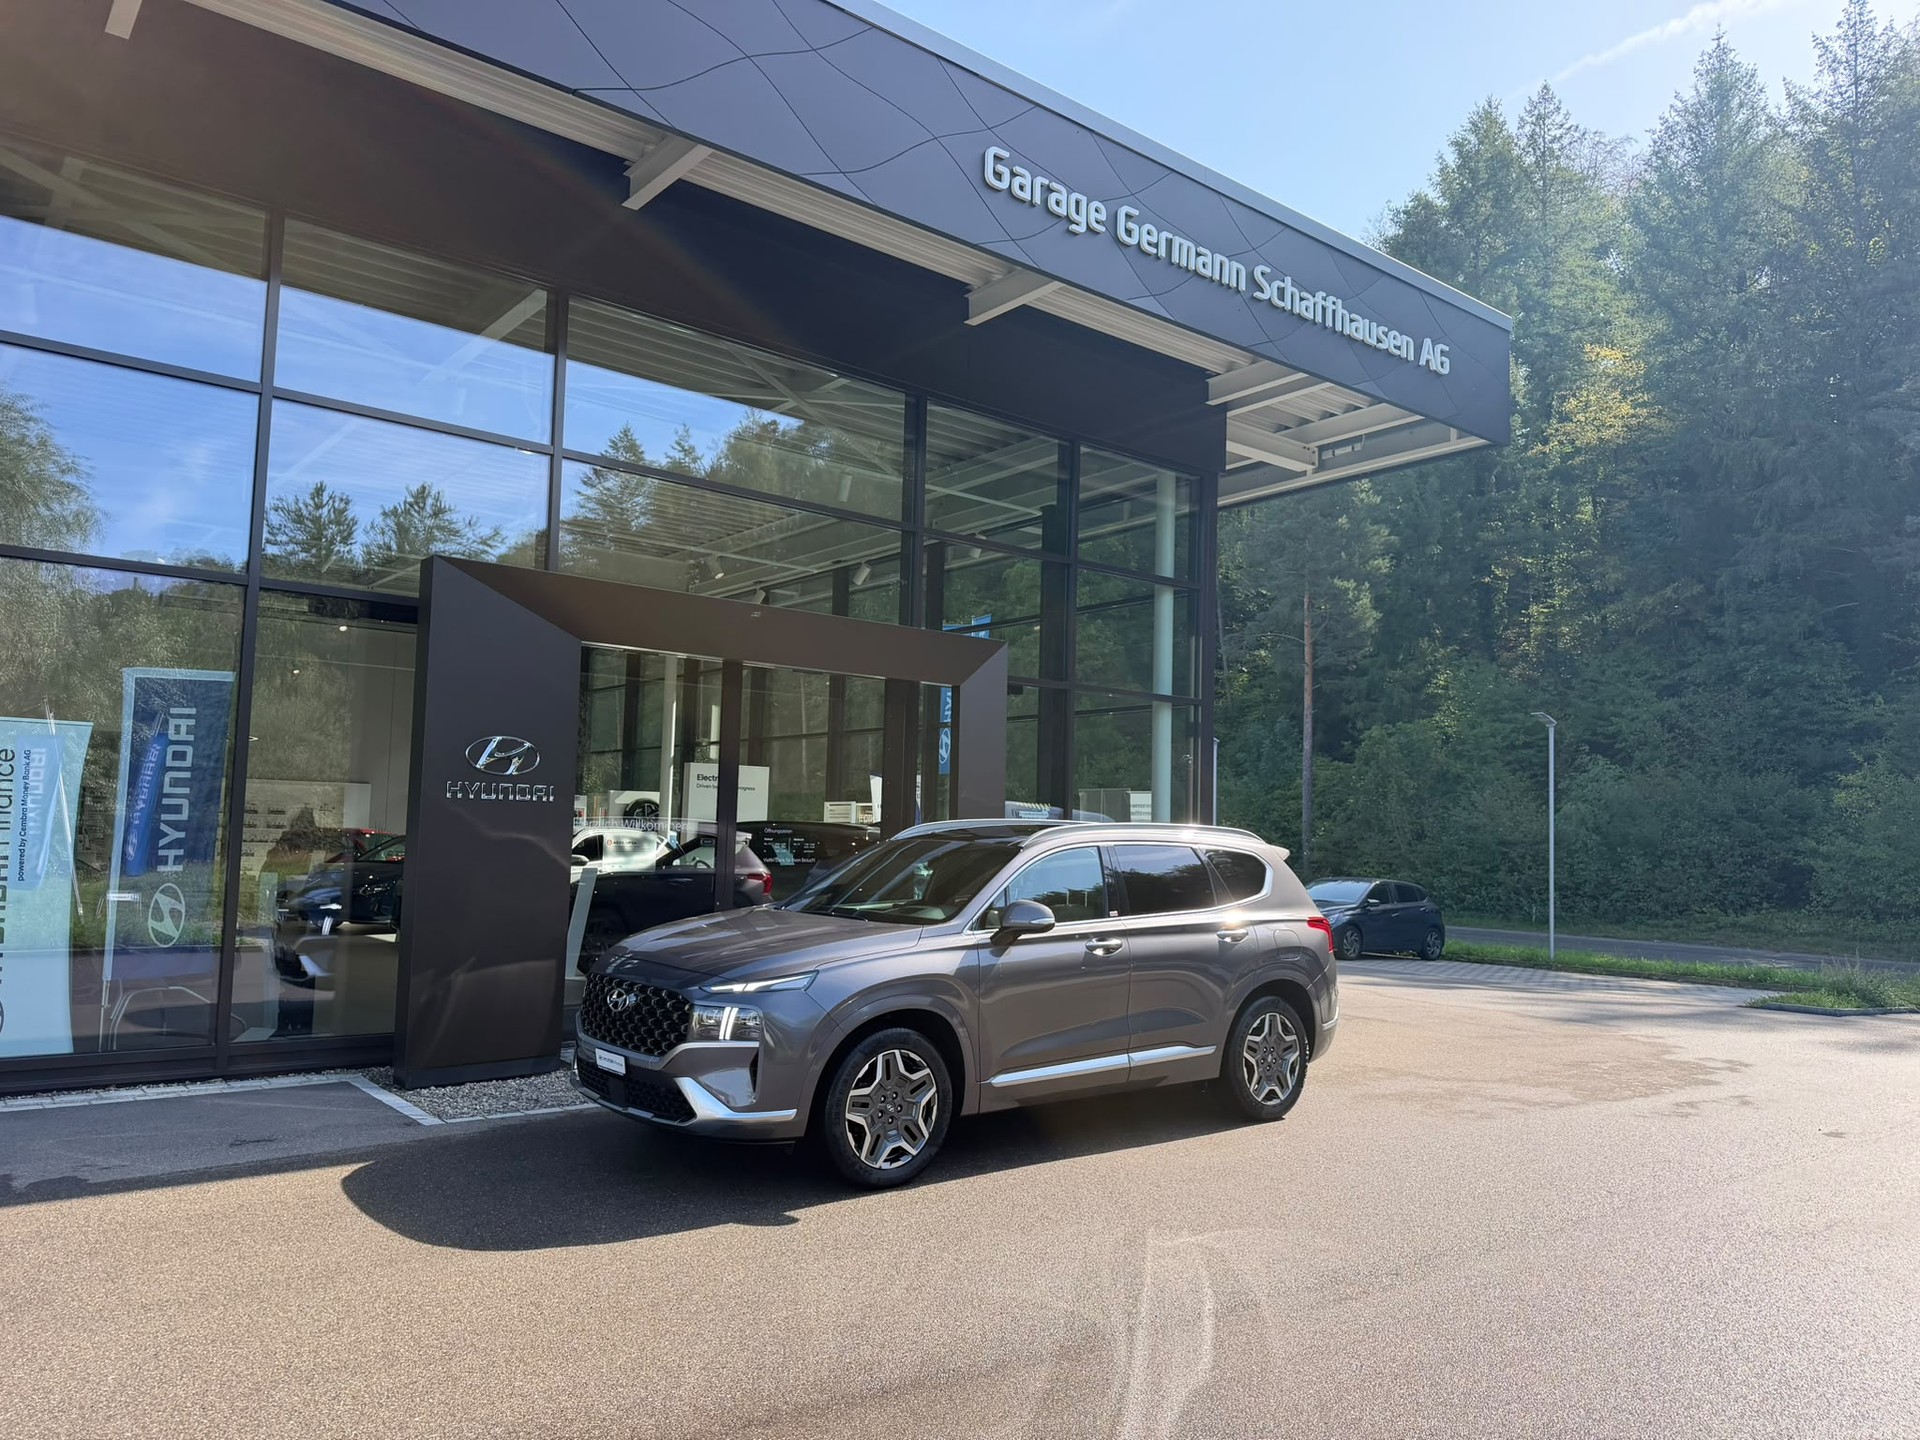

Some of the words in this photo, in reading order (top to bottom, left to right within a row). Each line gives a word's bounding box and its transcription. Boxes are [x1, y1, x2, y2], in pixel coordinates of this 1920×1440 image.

[983, 146, 1106, 234] Garage
[1116, 205, 1246, 292] Germann
[1253, 264, 1414, 361] Schaffhausen
[1419, 337, 1450, 376] AG
[23, 749, 31, 761] AG
[22, 761, 30, 780] Bank
[696, 773, 718, 782] Electr
[21, 781, 30, 806] Money
[157, 707, 197, 872] HYUNDAI
[446, 780, 554, 802] HYUNDAI
[19, 808, 28, 837] Cembra
[18, 838, 27, 848] by
[17, 849, 26, 882] powered
